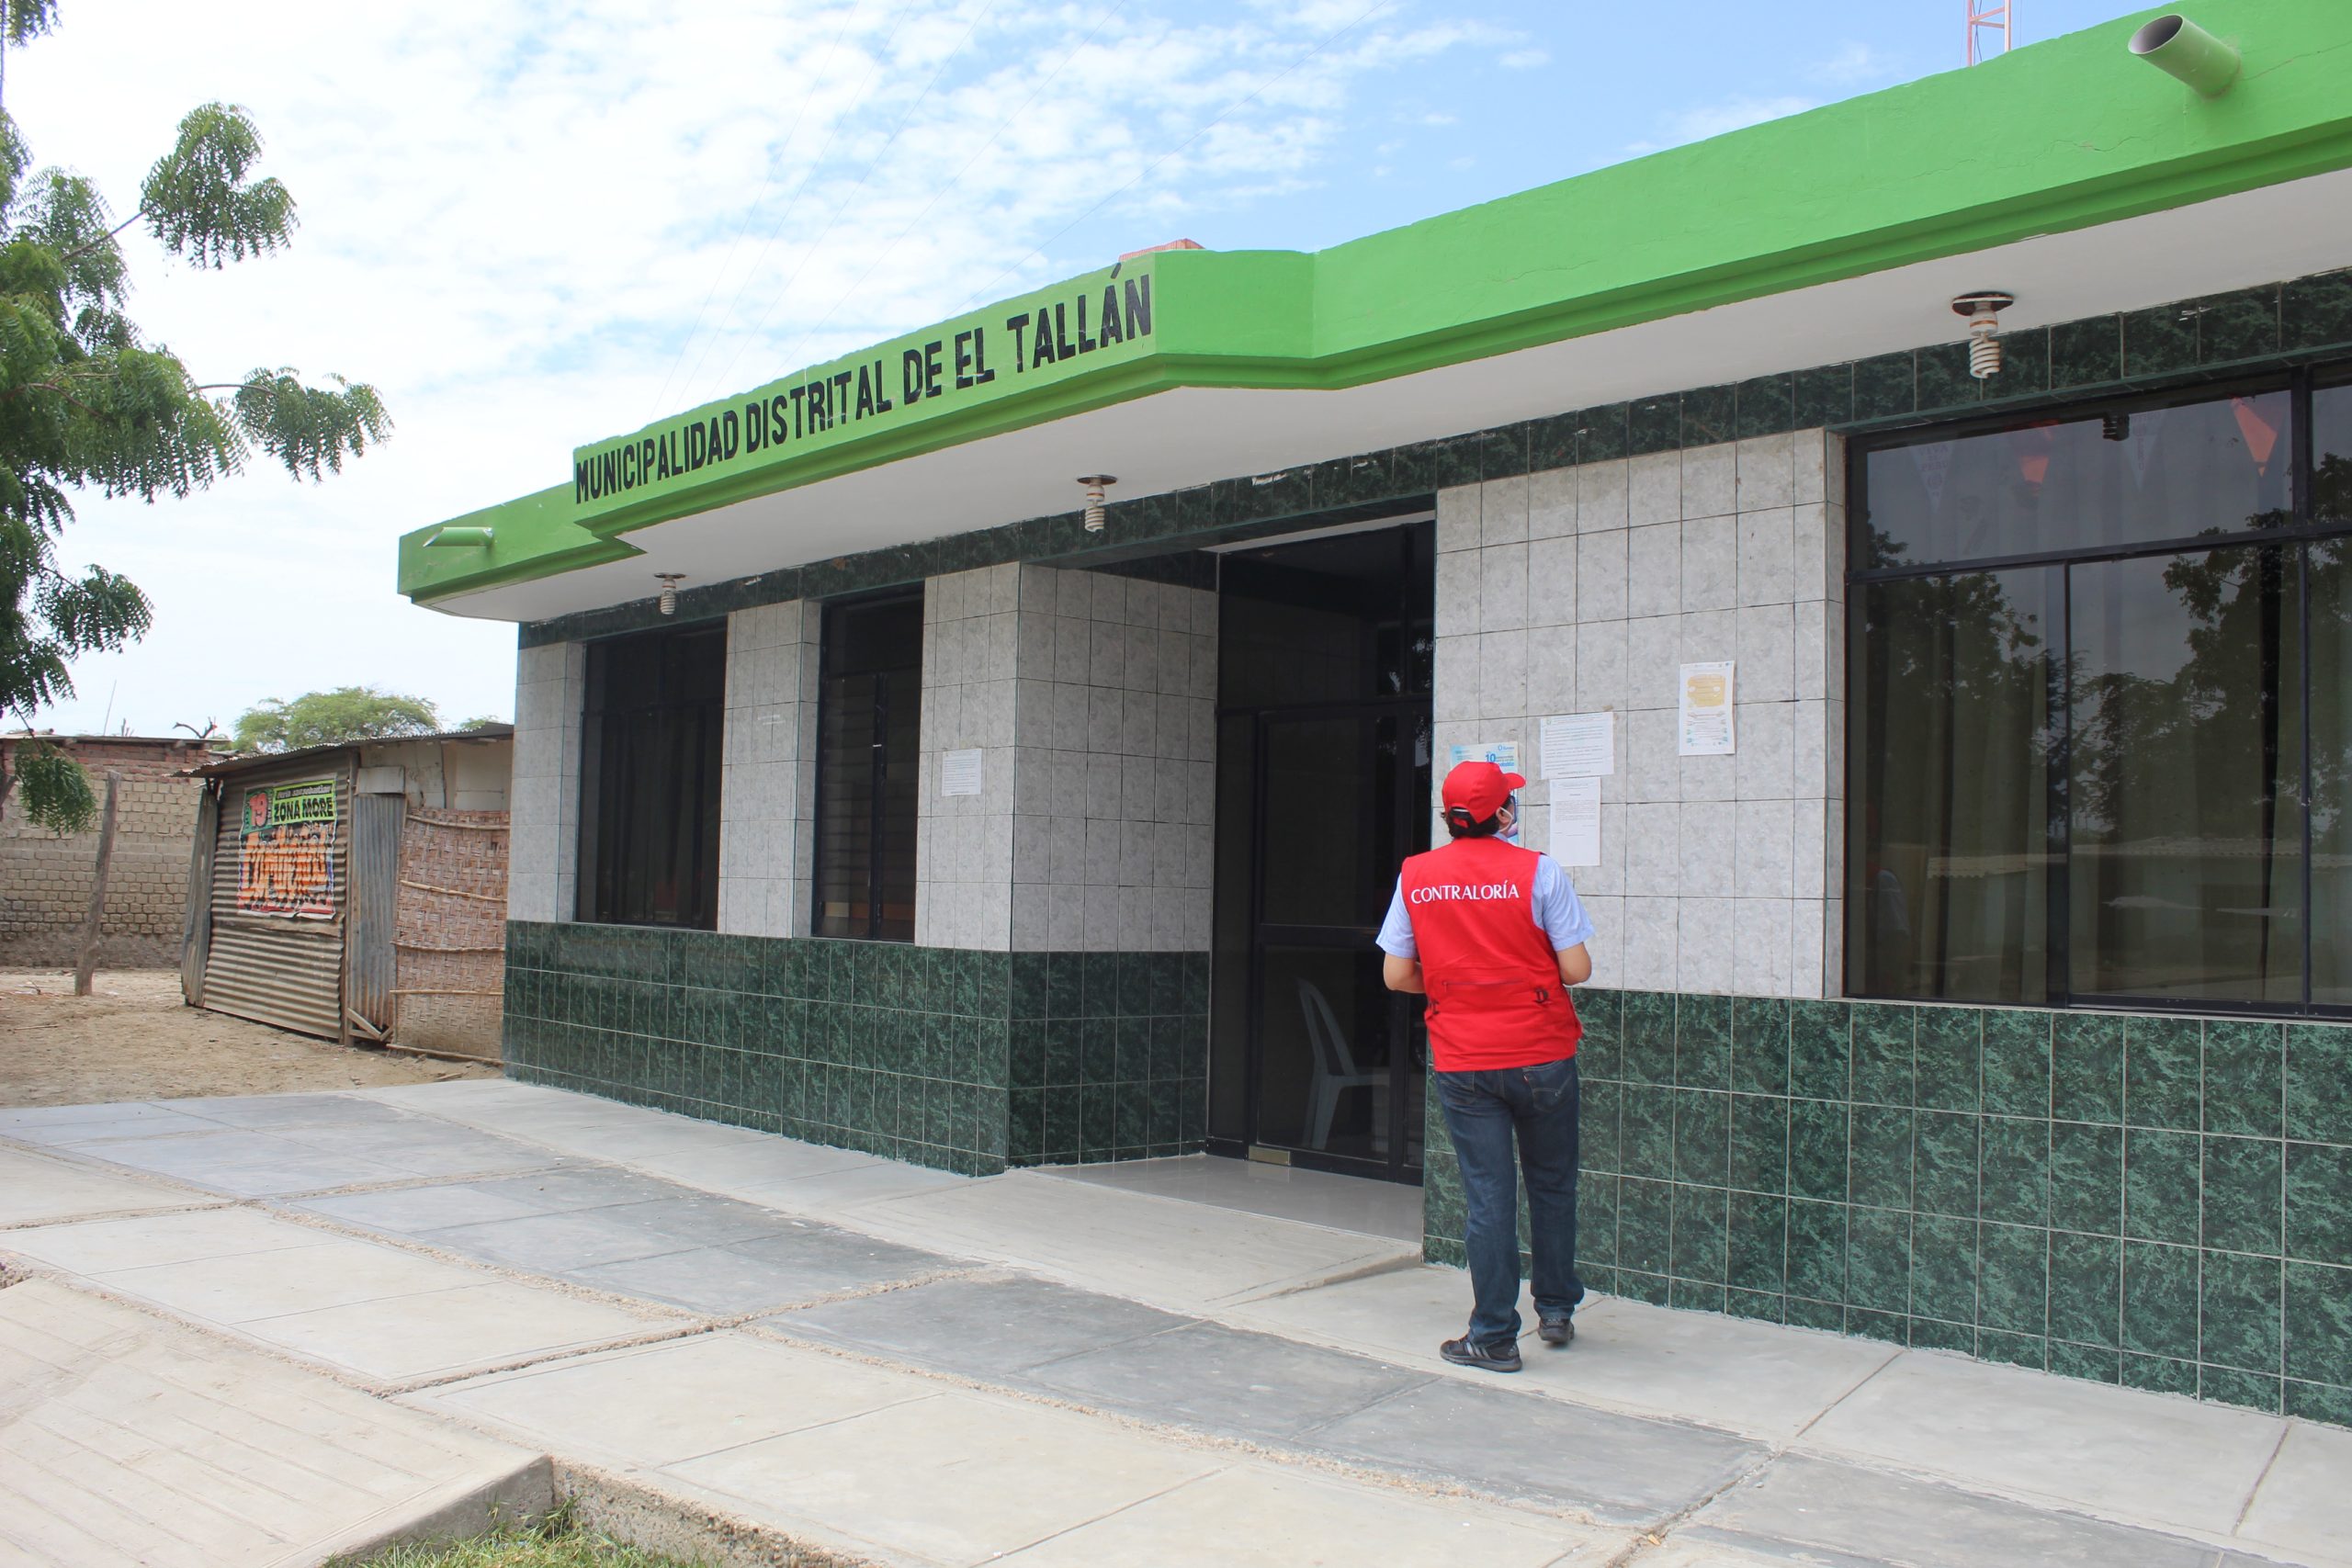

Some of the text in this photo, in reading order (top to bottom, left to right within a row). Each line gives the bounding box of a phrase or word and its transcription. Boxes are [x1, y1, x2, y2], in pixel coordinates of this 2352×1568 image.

[575, 262, 1152, 504] MUNICIPALIDAD DISTRITAL DE EL TALLÁN
[1485, 752, 1497, 763] 10
[249, 792, 267, 827] 19
[274, 800, 300, 822] ZONA
[301, 797, 334, 818] MORE
[1410, 879, 1520, 905] CONTRALORÍA
